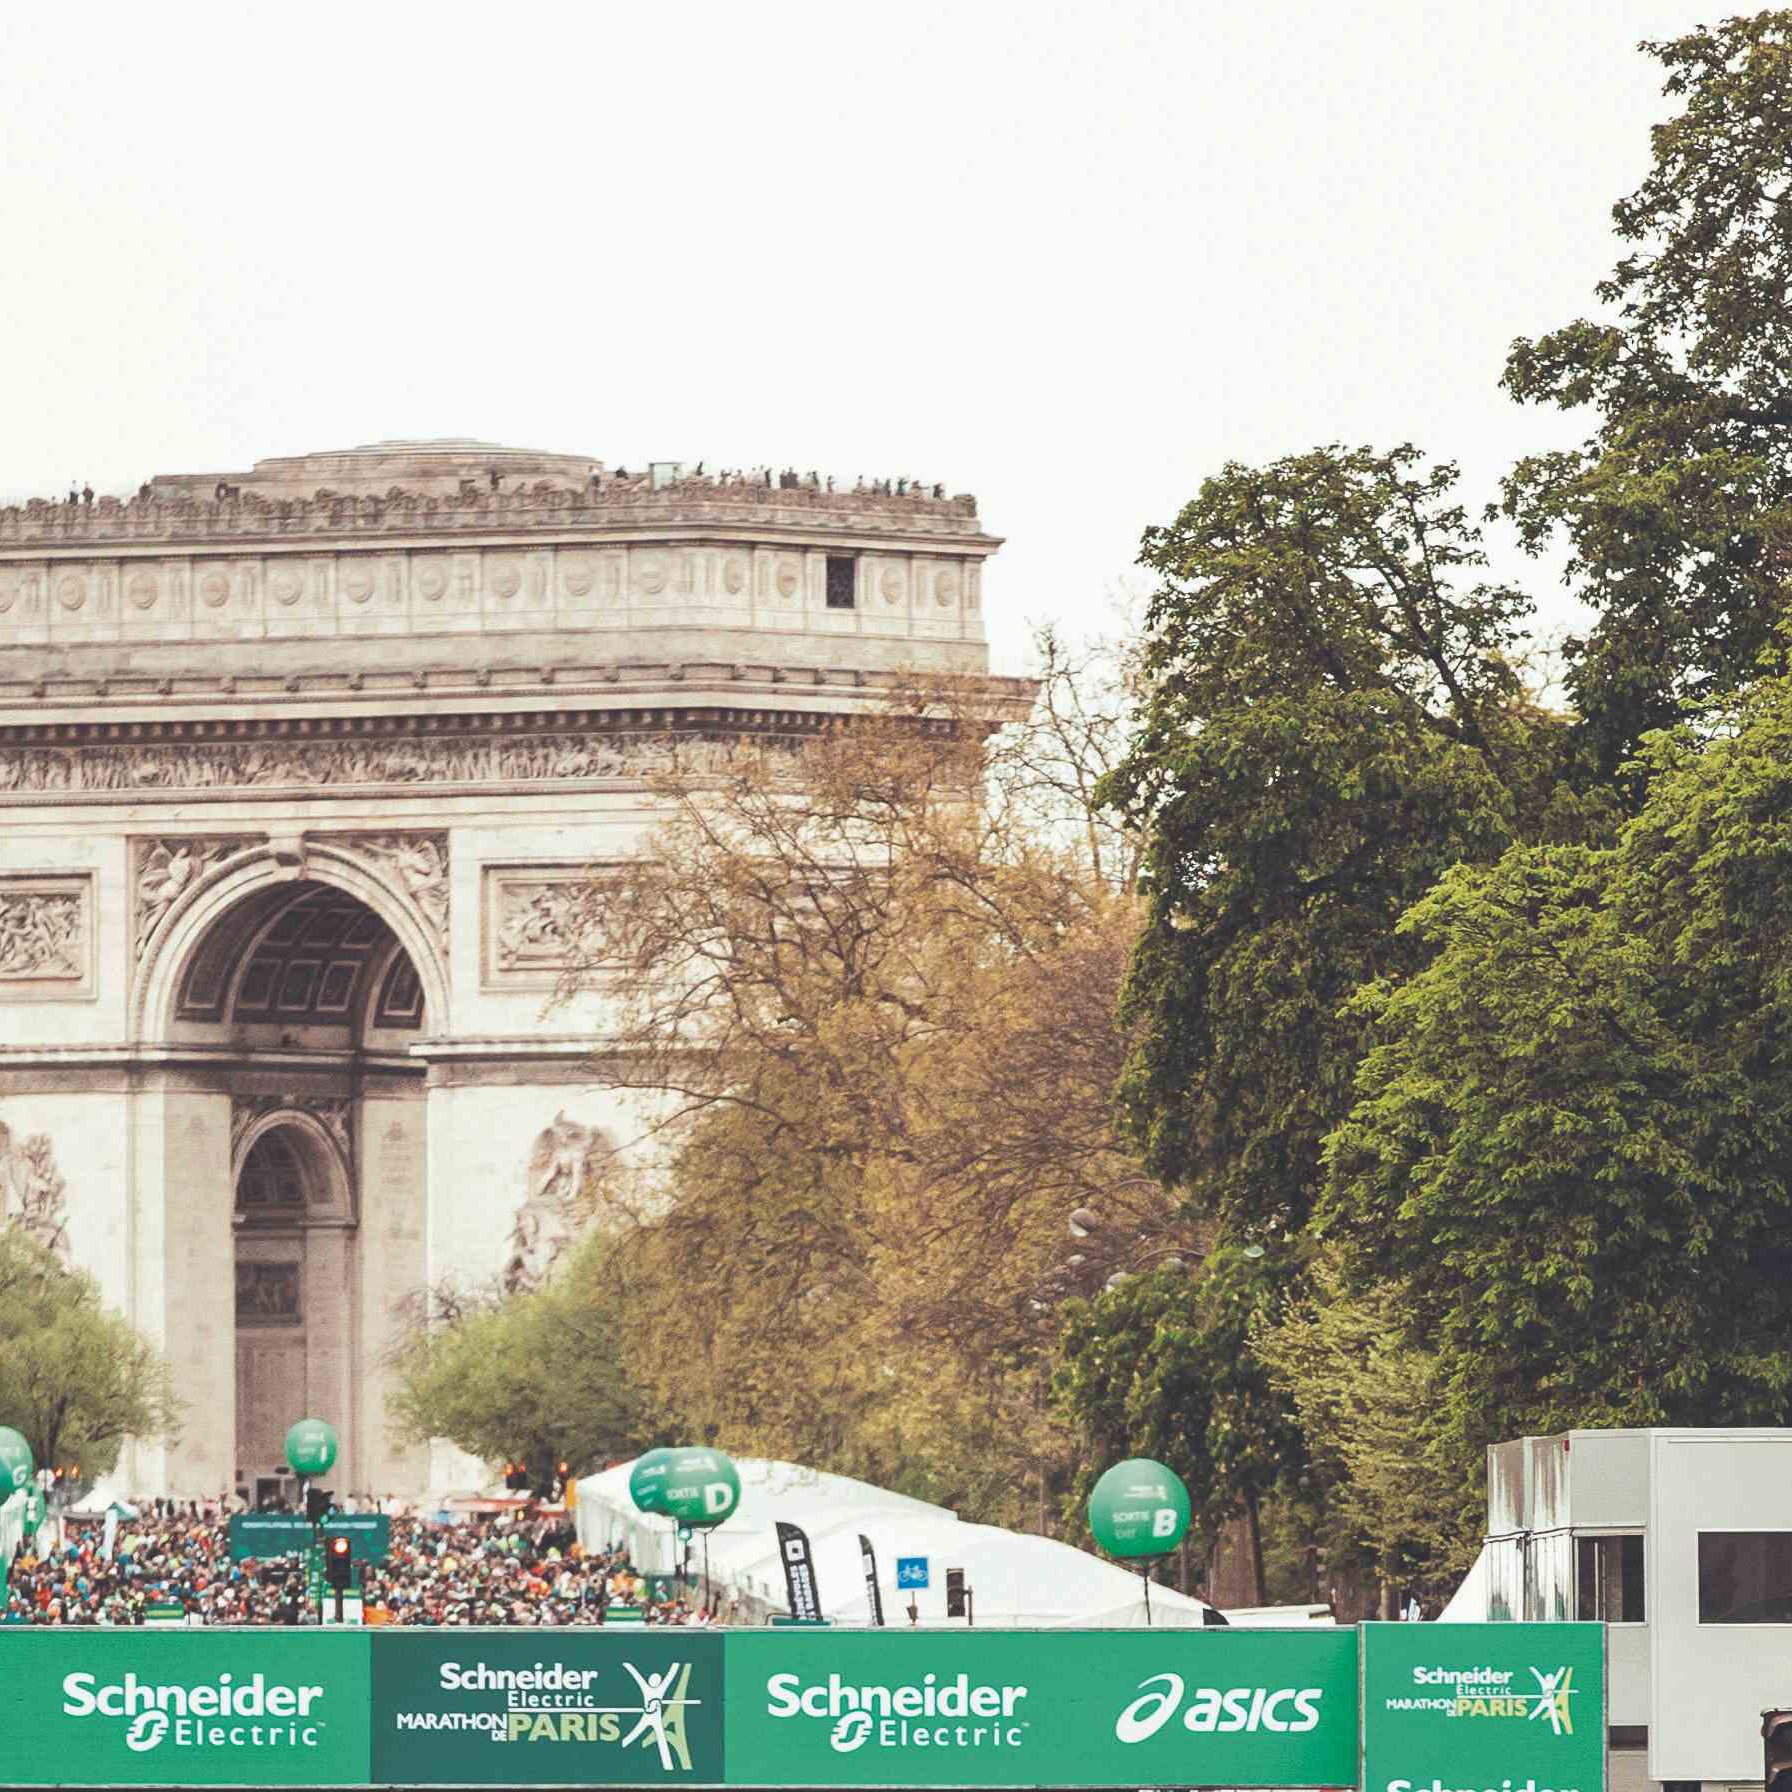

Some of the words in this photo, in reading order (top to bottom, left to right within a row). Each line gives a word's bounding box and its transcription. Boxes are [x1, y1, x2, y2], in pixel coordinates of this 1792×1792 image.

[704, 1483, 733, 1514] D
[1153, 1509, 1177, 1538] B
[440, 1663, 598, 1690] Schneider
[1413, 1667, 1513, 1684] Schneider
[63, 1672, 323, 1717] Schneider
[508, 1691, 594, 1708] Electric
[767, 1673, 1027, 1717] Schneider
[1457, 1685, 1511, 1695] Electric
[1386, 1699, 1456, 1710] MARATHON
[1457, 1699, 1528, 1717] PARIS
[175, 1720, 318, 1746] Electric
[397, 1713, 507, 1730] MARATHON
[507, 1714, 620, 1742] PARIS
[491, 1730, 507, 1741] DE
[879, 1719, 1023, 1746] Electric
